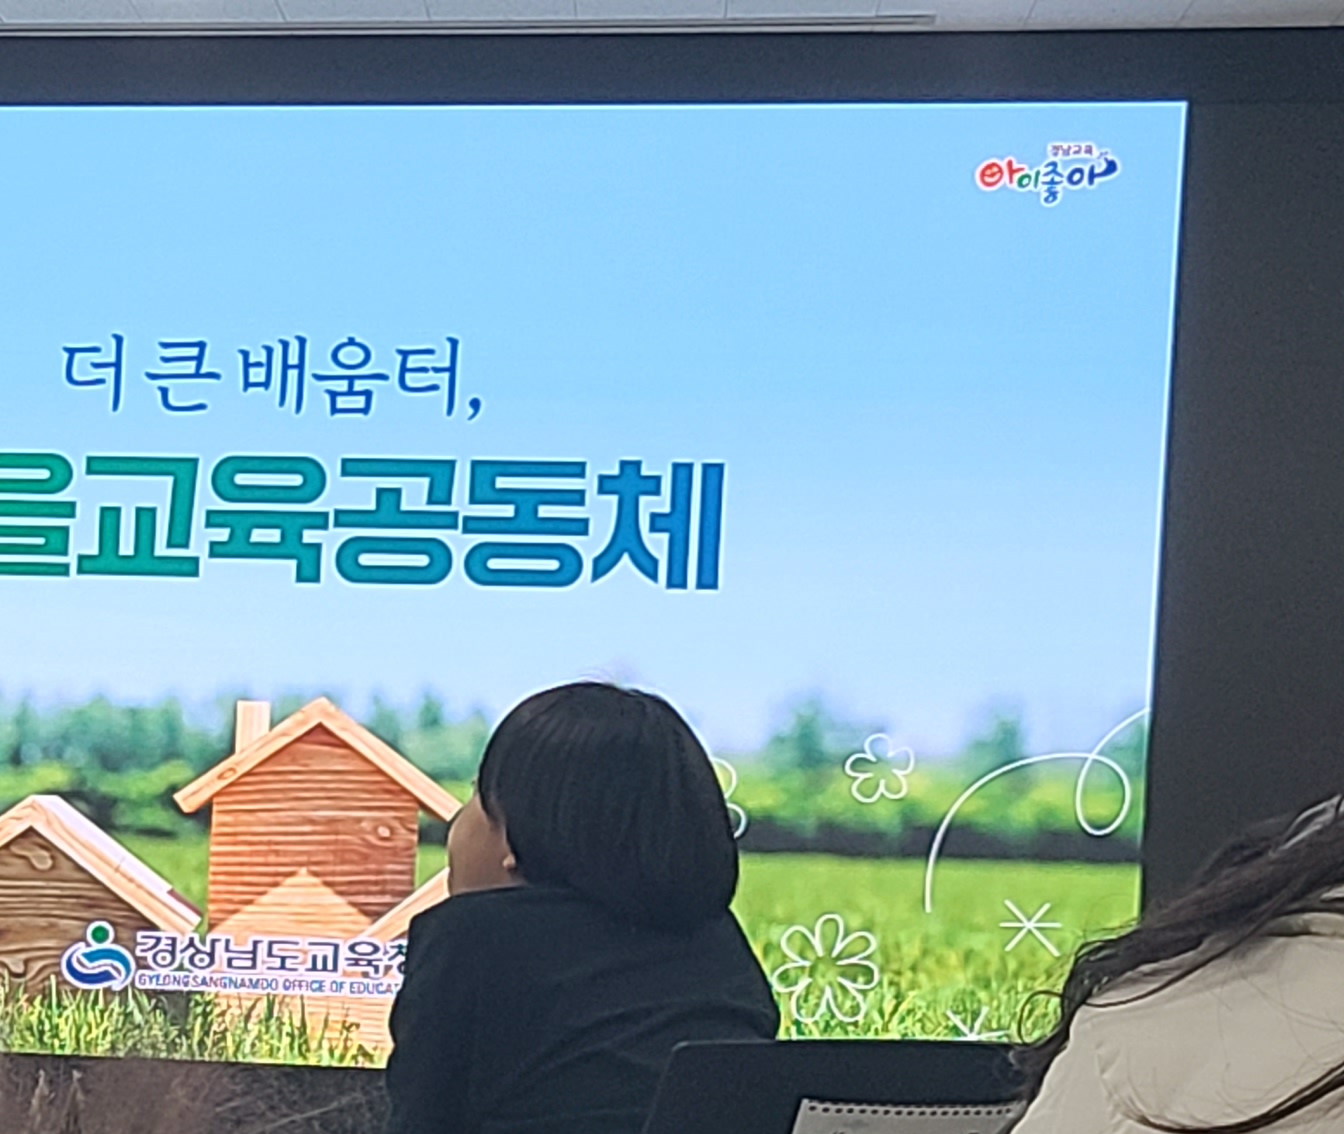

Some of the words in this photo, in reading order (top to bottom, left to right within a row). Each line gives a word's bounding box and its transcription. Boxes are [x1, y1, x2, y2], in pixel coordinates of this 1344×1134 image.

[979, 158, 1118, 204] 아이좋아
[62, 333, 124, 413] 더
[144, 340, 222, 412] 큰
[237, 334, 483, 421] 배움터,
[138, 972, 279, 991] GYEONGSANGNAMDO
[282, 978, 326, 993] OFFICE
[330, 980, 347, 994] OF
